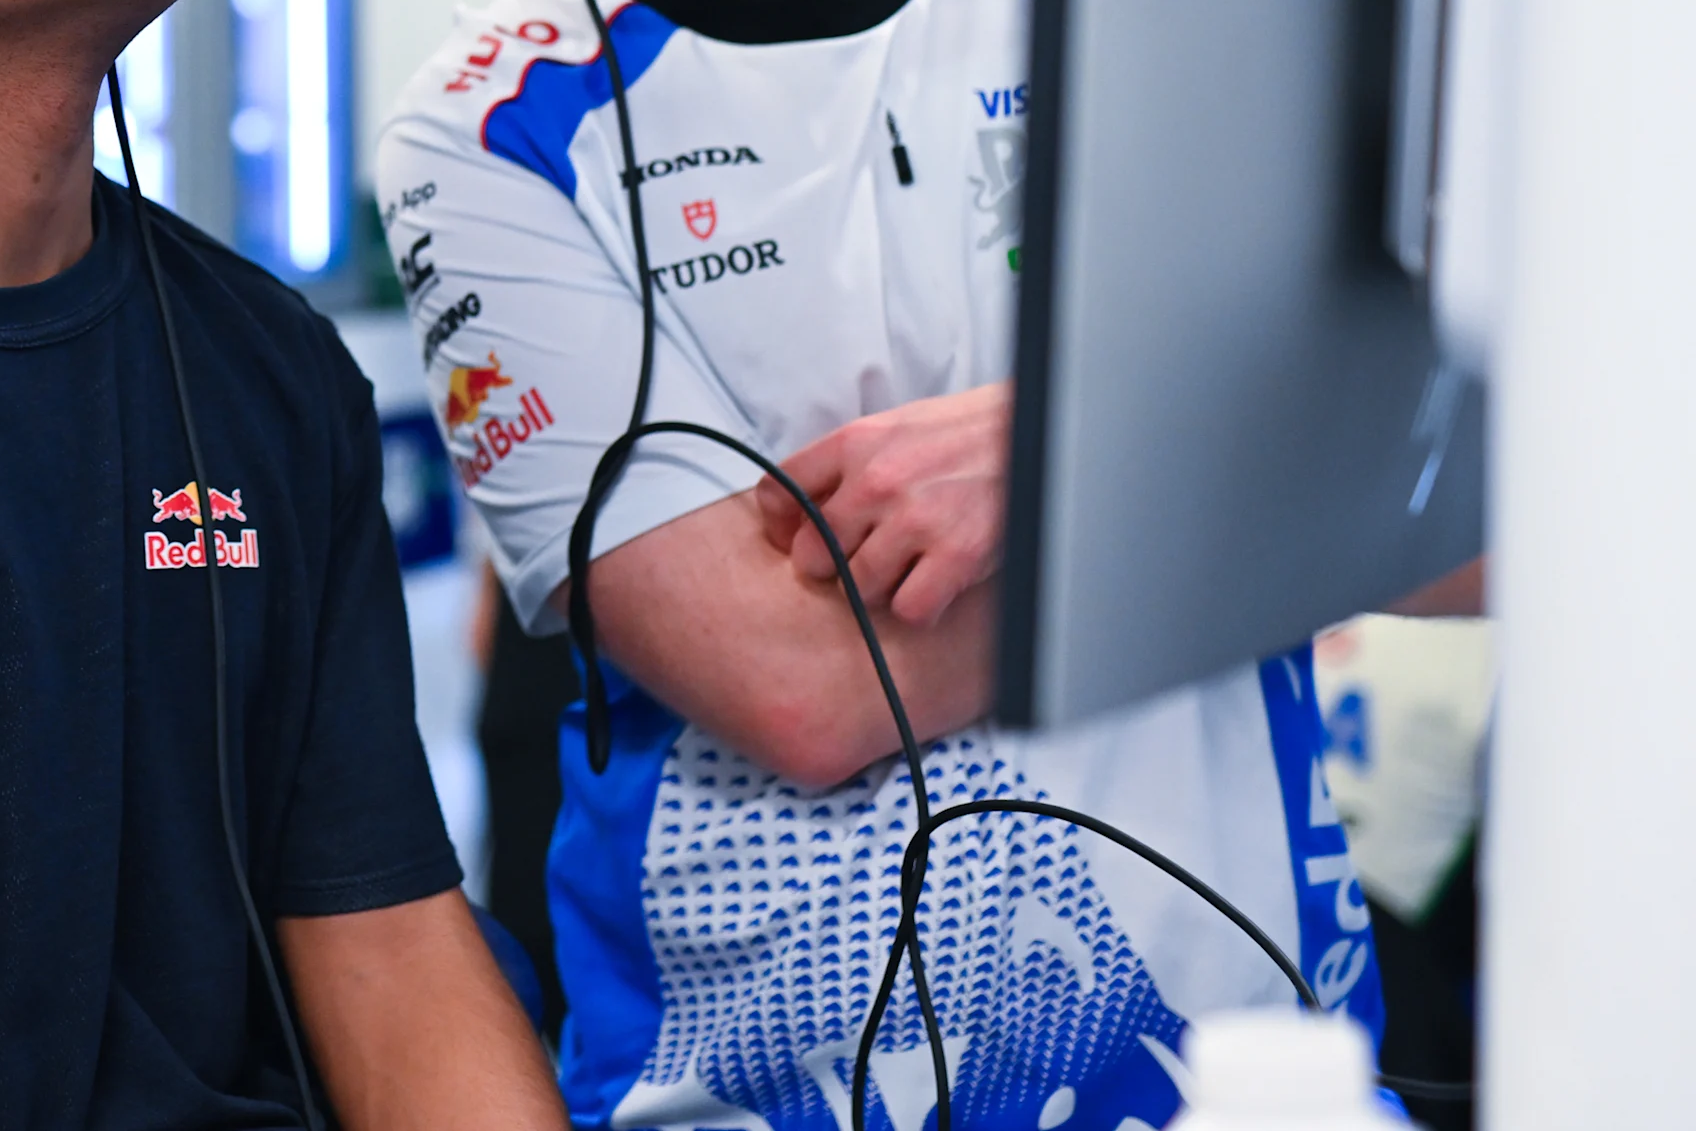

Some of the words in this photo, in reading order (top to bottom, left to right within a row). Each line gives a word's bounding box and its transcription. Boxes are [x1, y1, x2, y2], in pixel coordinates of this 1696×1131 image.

[976, 84, 1029, 118] VIS
[648, 239, 785, 294] TUDOR
[484, 387, 555, 459] Bull
[144, 528, 207, 569] Red
[213, 529, 259, 568] Bull
